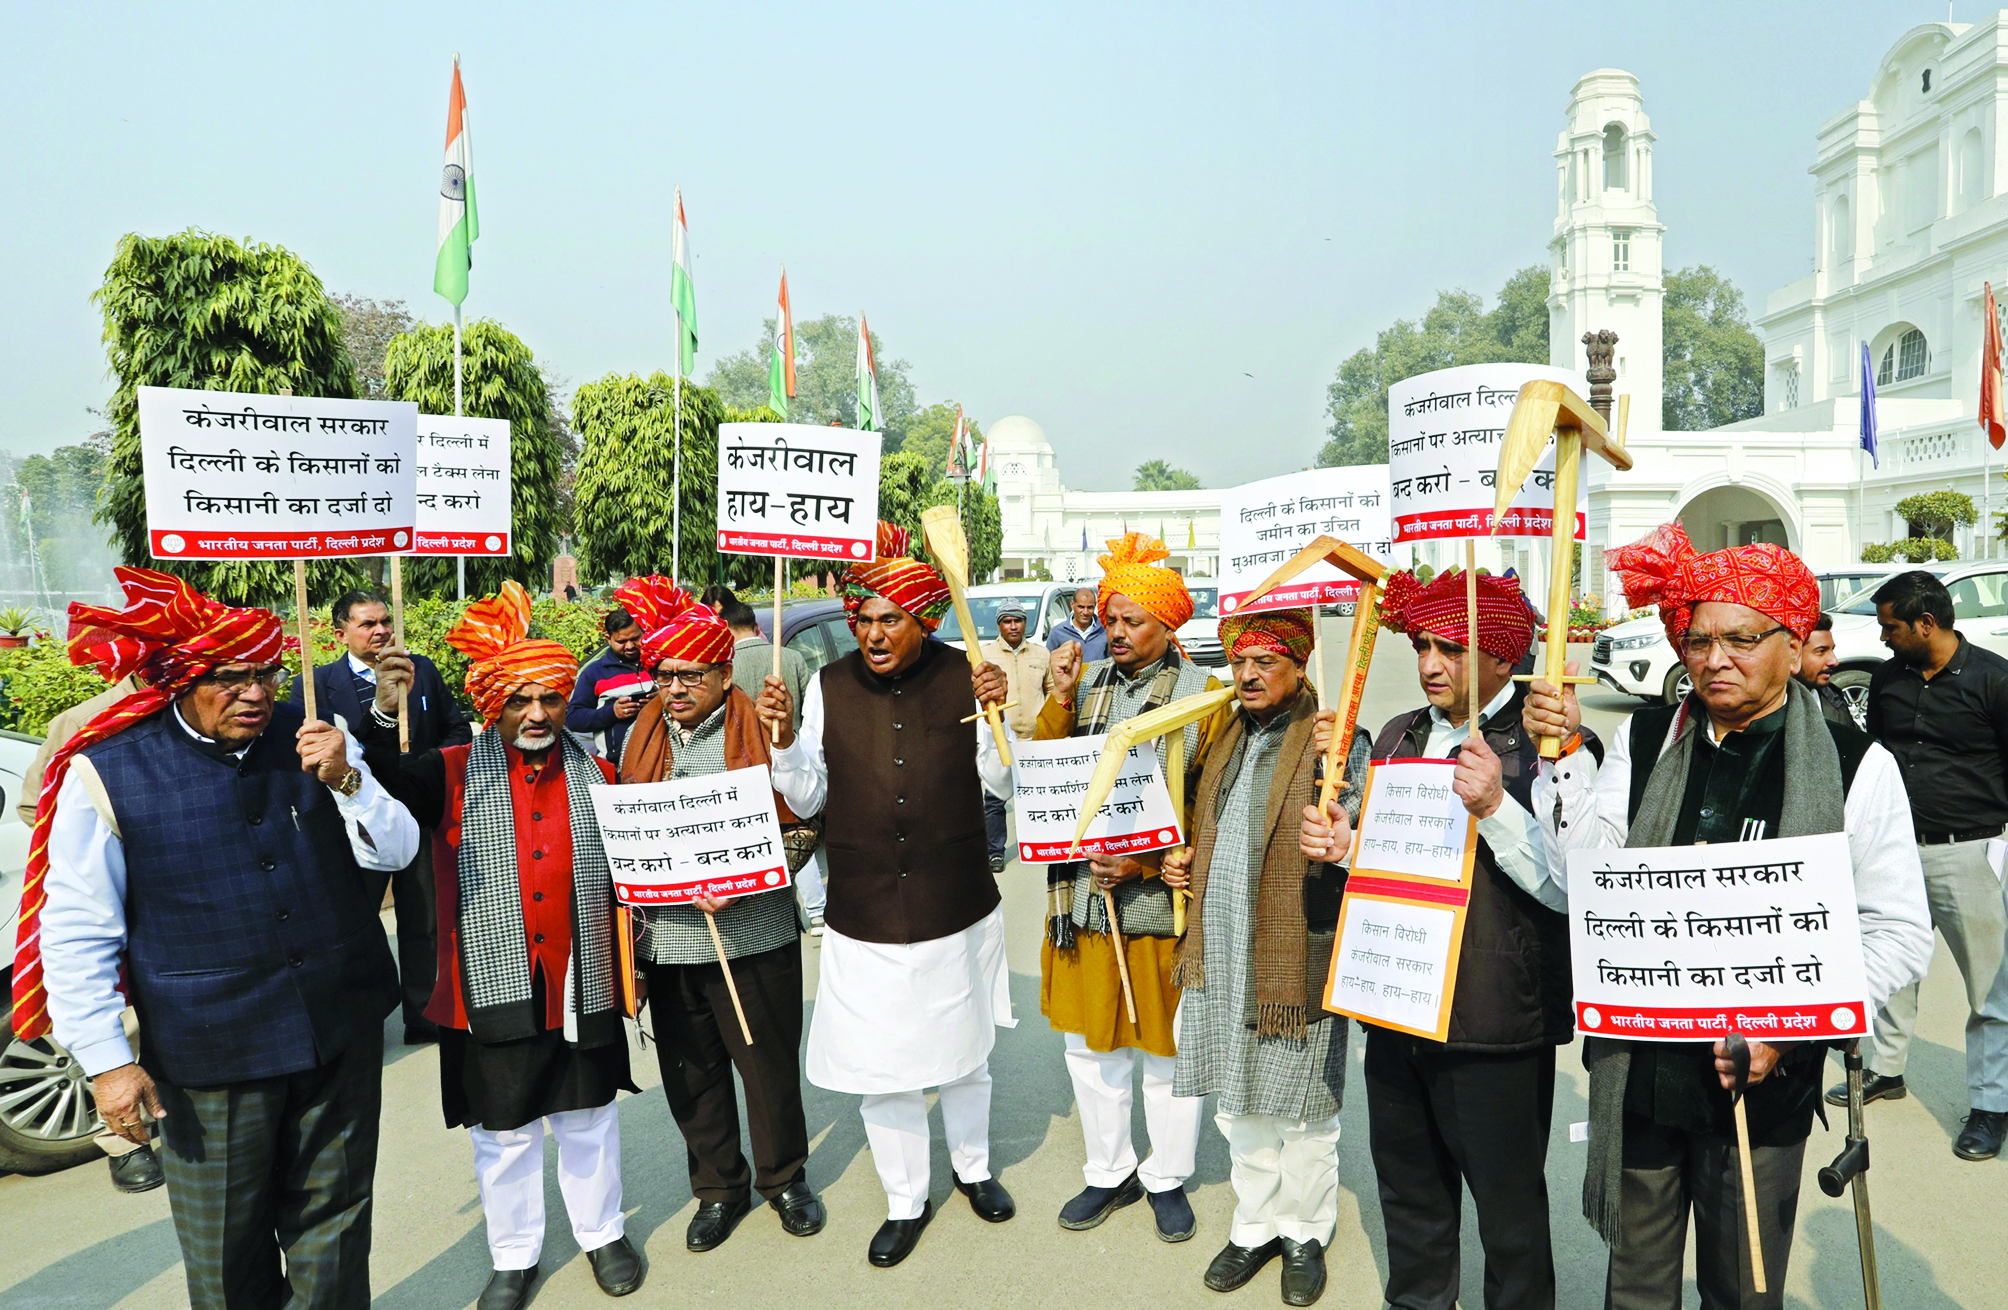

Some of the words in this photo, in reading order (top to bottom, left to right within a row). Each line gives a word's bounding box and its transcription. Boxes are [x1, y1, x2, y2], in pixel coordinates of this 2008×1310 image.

[1404, 392, 1472, 418] केजरीवाल
[182, 403, 311, 433] केजरीवाल
[318, 416, 389, 436] सरकार
[429, 432, 473, 449] दिल्ली
[477, 434, 489, 449] में
[1391, 431, 1425, 459] किसानों
[1429, 433, 1447, 449] पर
[167, 446, 246, 473] दिल्ली
[253, 450, 281, 474] के
[287, 451, 370, 475] किसानों
[374, 452, 401, 475] को
[726, 436, 858, 477] केजरीवाल
[432, 462, 467, 479] टैक्स
[471, 465, 500, 480] लेना
[1392, 478, 1413, 500] बन्द
[1416, 465, 1451, 495] करो
[183, 489, 279, 515] किसानी
[286, 497, 320, 515] का
[326, 490, 367, 517] दर्जा
[372, 491, 392, 512] दो
[416, 494, 437, 511] न्द
[442, 490, 481, 509] करो
[1240, 502, 1276, 523] दिल्ली
[1281, 499, 1295, 516] के
[1299, 491, 1353, 513] किसानों
[1358, 490, 1380, 507] को
[1256, 524, 1293, 542] जमीन
[1297, 522, 1317, 536] का
[1320, 516, 1361, 533] उचित
[1403, 520, 1427, 533] भारतीय
[1429, 519, 1453, 530] जनता
[1524, 514, 1552, 530] प्रदेश
[198, 538, 249, 551] भारतीय
[252, 538, 287, 550] जनता
[325, 536, 358, 550] दिल्ली
[361, 536, 385, 549] प्रदेश
[417, 536, 449, 548] दिल्ली
[451, 536, 476, 549] प्रदेश
[729, 536, 748, 546] भारतीय
[750, 537, 768, 548] जनता
[792, 540, 818, 551] दिल्ली
[821, 541, 843, 553] प्रदेश
[1231, 550, 1285, 574] मुआवजा
[1376, 536, 1391, 556] दो
[1275, 592, 1298, 602] जनता
[1325, 586, 1352, 598] दिल्ली
[1018, 756, 1053, 769] केजरीवाल
[1055, 755, 1090, 769] सरकार
[1128, 745, 1138, 758] में
[1036, 786, 1048, 796] पर
[1049, 779, 1089, 795] कमर्शिय
[1130, 772, 1154, 785] लेना
[1385, 783, 1412, 798] किसान
[1417, 783, 1449, 801] विरोधी
[613, 799, 676, 815] केजरीवाल
[679, 790, 722, 810] दिल्ली
[726, 786, 738, 801] में
[1028, 810, 1049, 823] बन्द
[1052, 803, 1076, 822] करो
[1114, 796, 1144, 816] करो
[603, 825, 641, 841] किसानों
[644, 830, 661, 840] पर
[666, 821, 725, 838] अत्याचार
[730, 812, 769, 829] करना
[1374, 809, 1413, 826] केजरीवाल
[1419, 815, 1455, 830] सरकार
[611, 857, 638, 874] बन्द
[639, 852, 672, 873] करो
[695, 849, 731, 866] बन्द
[734, 836, 772, 861] करो
[1036, 846, 1062, 856] भारतीय
[1105, 839, 1129, 851] दिल्ली
[1130, 836, 1151, 846] प्रदेश
[633, 889, 659, 899] भारतीय
[662, 887, 682, 898] जनता
[707, 881, 734, 892] दिल्ली
[735, 878, 757, 889] प्रदेश
[1592, 863, 1706, 891] केजरीवाल
[1712, 861, 1804, 887] सरकार
[1361, 919, 1389, 940] किसान
[1394, 924, 1427, 945] विरोधी
[1584, 910, 1645, 940] दिल्ली
[1650, 911, 1678, 939] के
[1684, 906, 1783, 937] किसानों
[1789, 902, 1830, 932] को
[1351, 946, 1390, 968] केजरीवाल
[1396, 957, 1433, 975] सरकार
[1596, 958, 1681, 988] किसानी
[1687, 967, 1725, 988] का
[1731, 956, 1786, 989] दर्जा
[1792, 954, 1823, 987] दो
[1610, 1014, 1655, 1029] भारतीय
[1659, 1017, 1693, 1030] जनता
[1737, 1014, 1778, 1030] दिल्ली
[1782, 1014, 1816, 1029] प्रदेश
